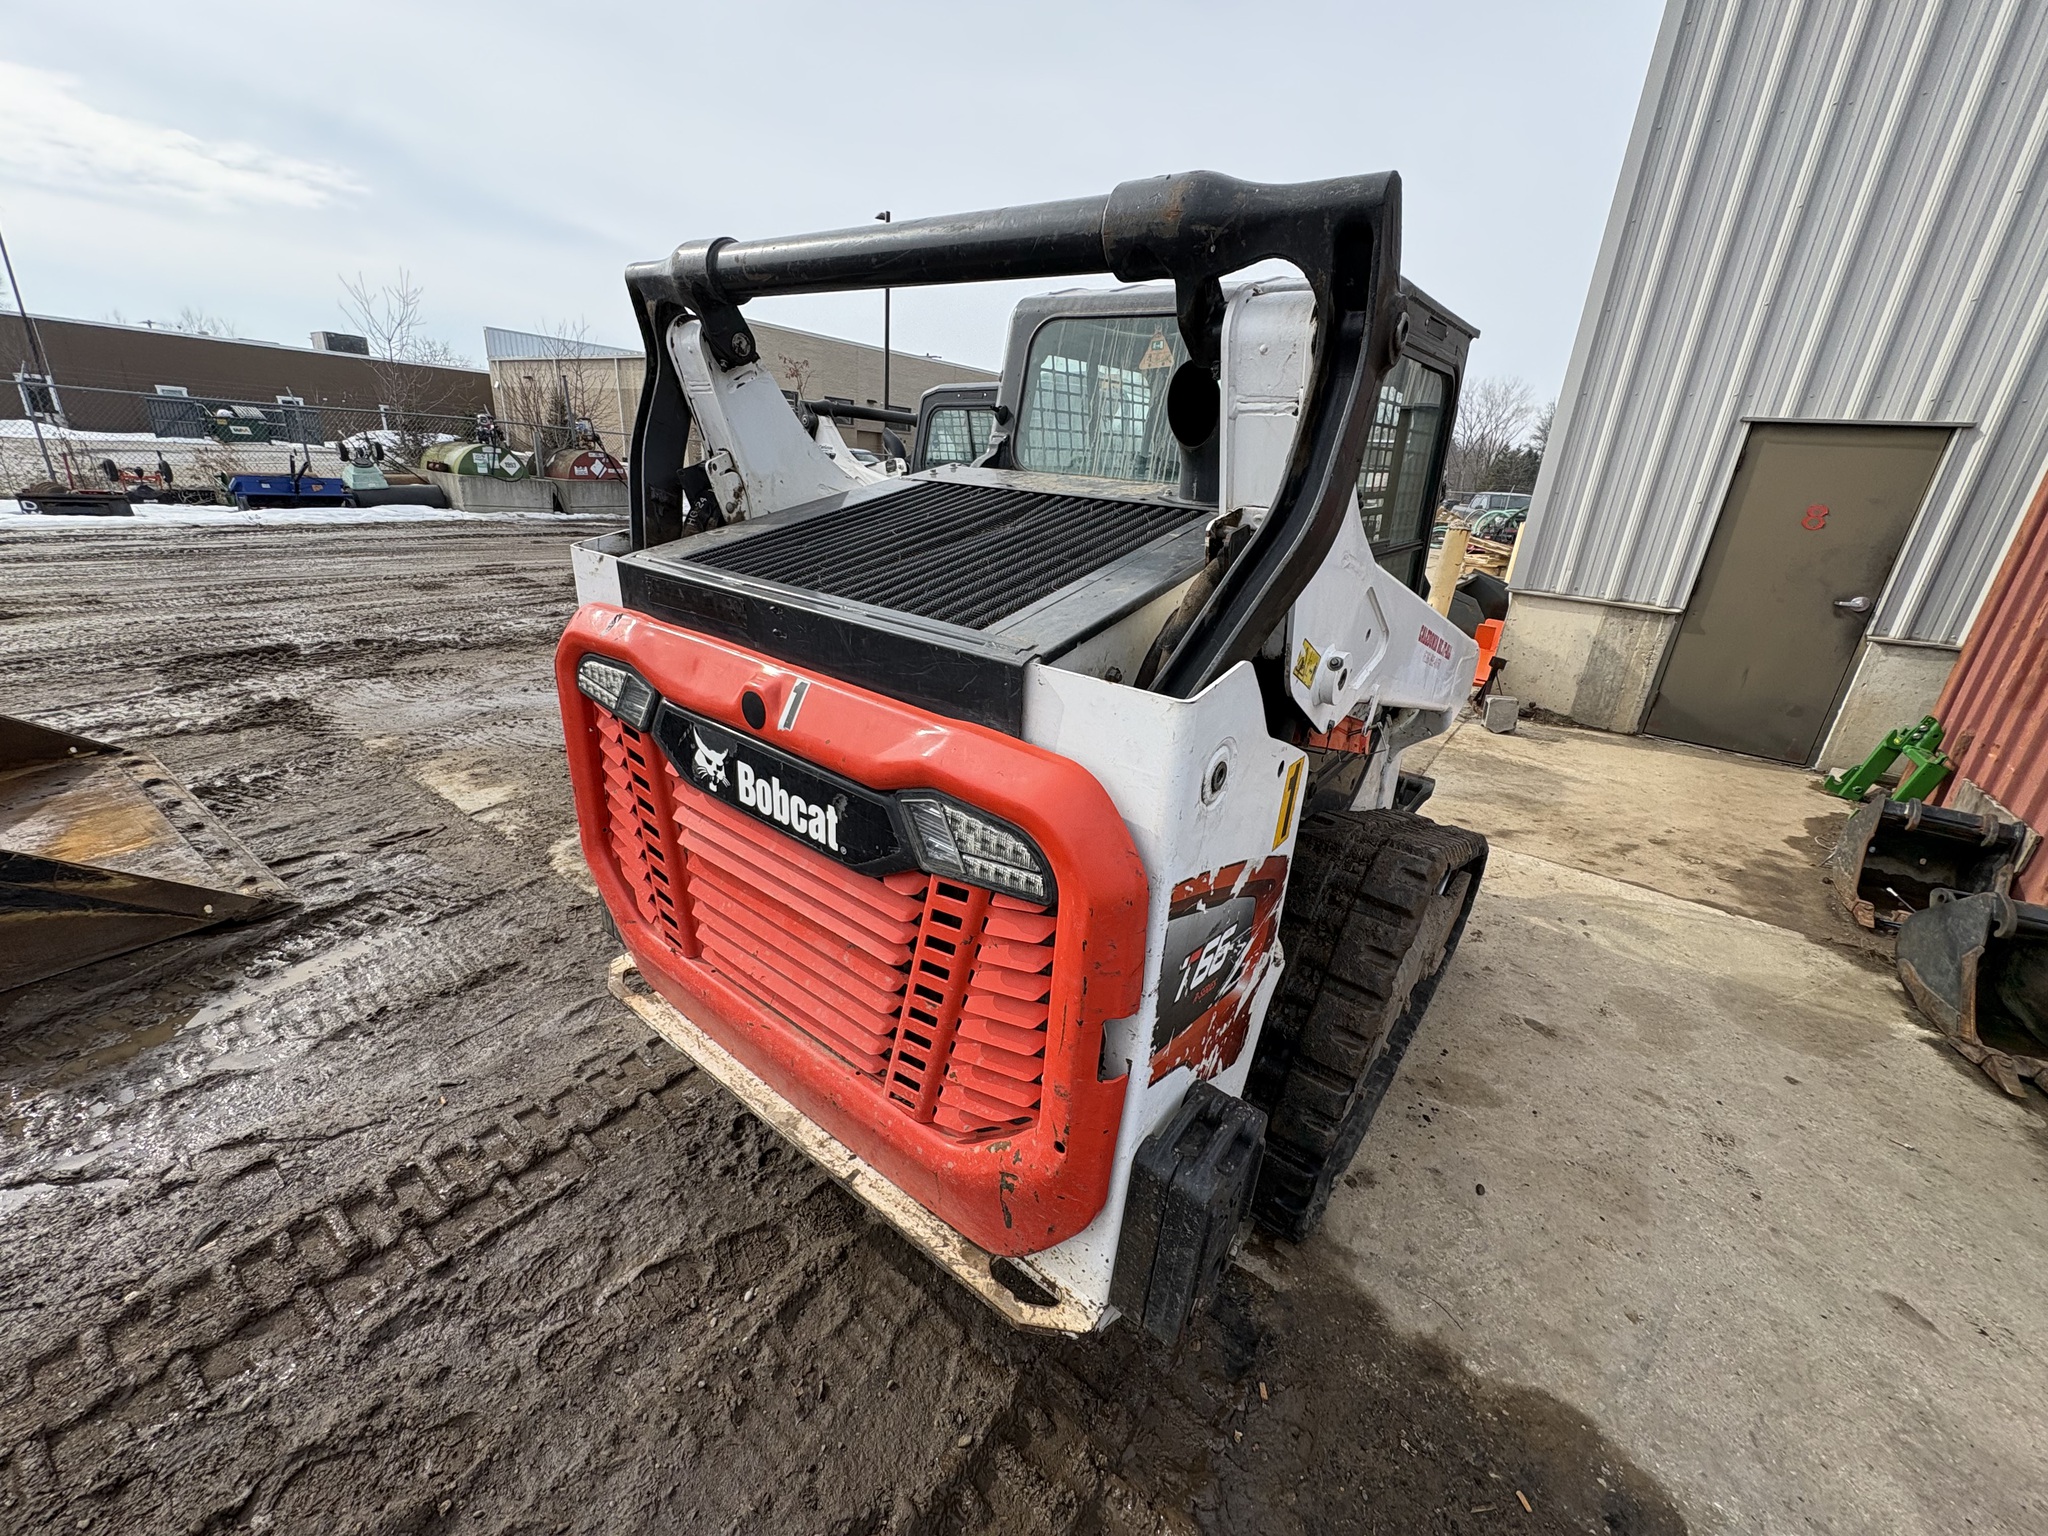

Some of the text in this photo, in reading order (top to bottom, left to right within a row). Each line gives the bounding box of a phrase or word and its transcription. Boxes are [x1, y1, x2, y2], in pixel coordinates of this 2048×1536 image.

[1801, 503, 1829, 531] 8
[781, 681, 809, 731] 1
[737, 760, 838, 852] Bobcat
[1279, 759, 1303, 841] 1
[1173, 923, 1238, 1004] T66
